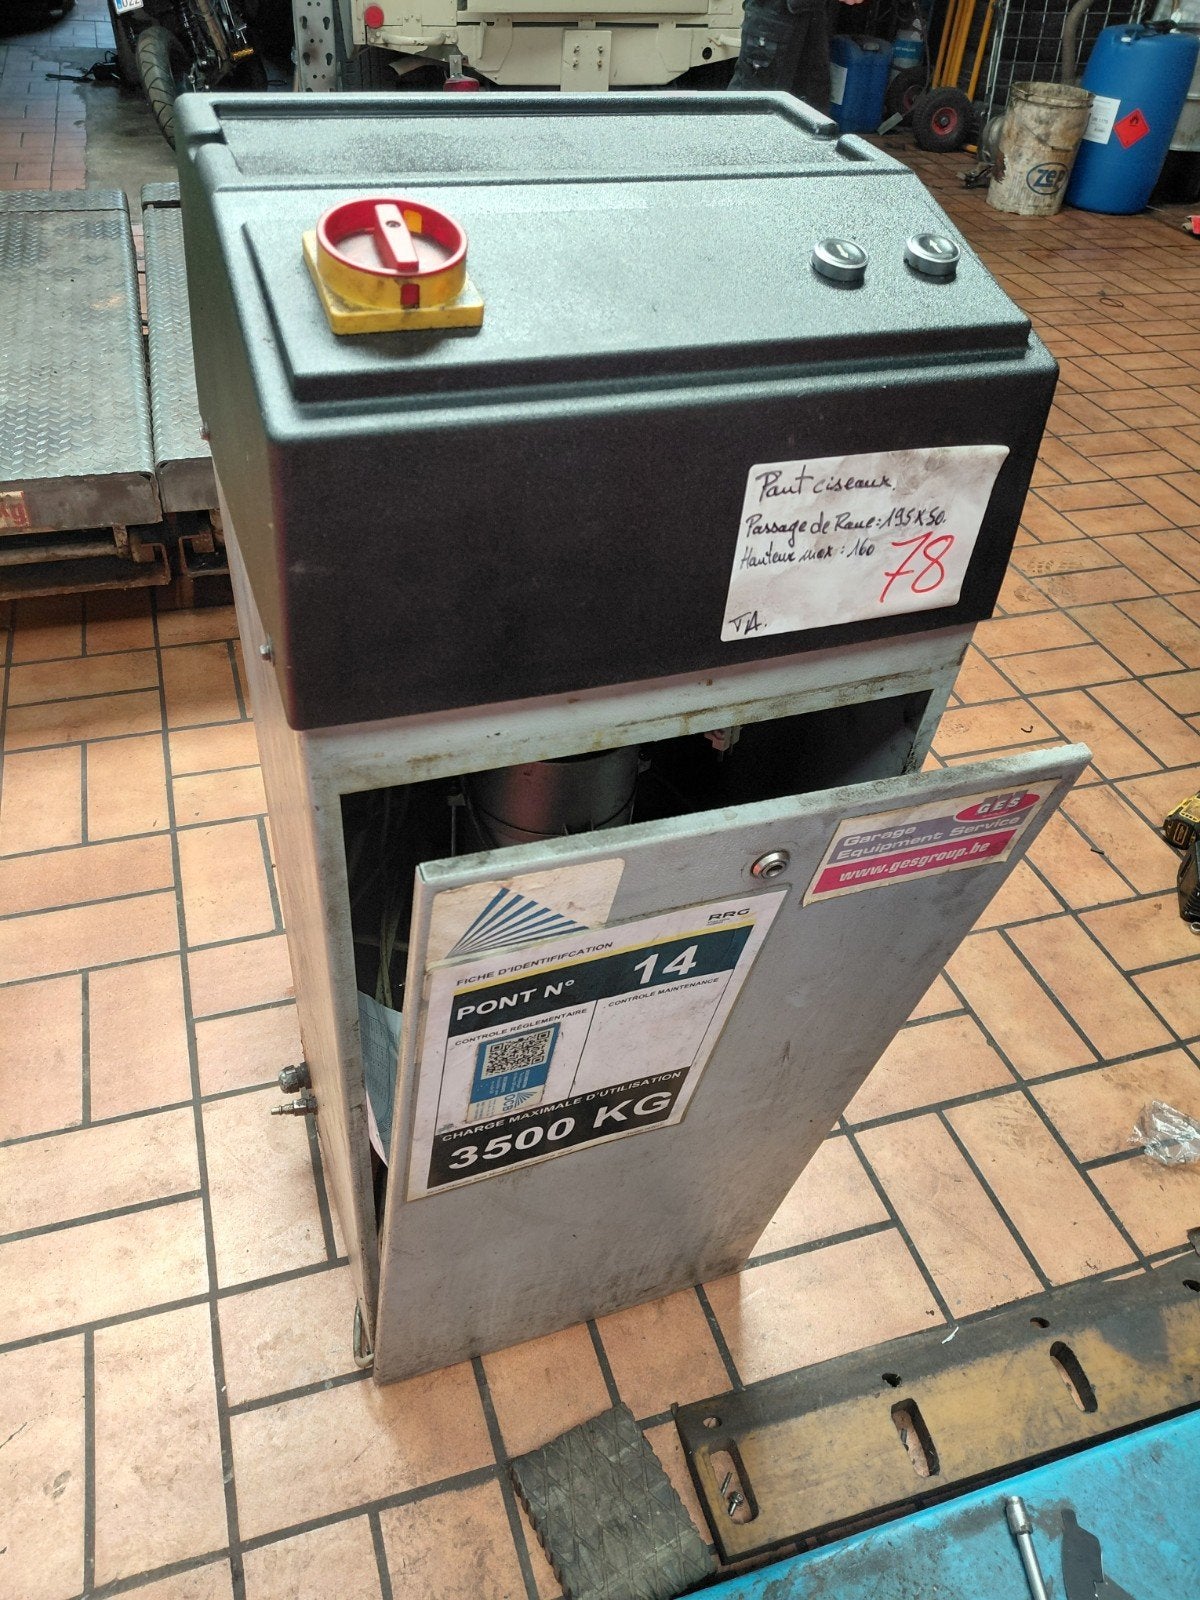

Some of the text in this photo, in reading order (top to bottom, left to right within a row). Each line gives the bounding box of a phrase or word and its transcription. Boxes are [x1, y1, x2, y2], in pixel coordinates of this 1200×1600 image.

[745, 513, 808, 548] Passage
[810, 511, 831, 534] de
[878, 530, 956, 604] 78
[976, 796, 1022, 815] GES
[836, 815, 1021, 860] Equipment Service
[843, 825, 917, 848] Garage
[839, 840, 991, 883] www.gesgroup.be
[708, 908, 751, 921] RRG
[456, 971, 495, 986] FICHE
[456, 988, 538, 1021] PONT
[634, 944, 699, 985] 14
[608, 977, 720, 1008] CONTROLE MAINTENANCE
[454, 1028, 508, 1046] CONTROLE
[442, 1119, 505, 1142] CHARGE
[508, 1098, 582, 1124] MAXIMALE
[586, 1071, 682, 1101] D'UTILISATION
[448, 1091, 673, 1170] 3500 KG
